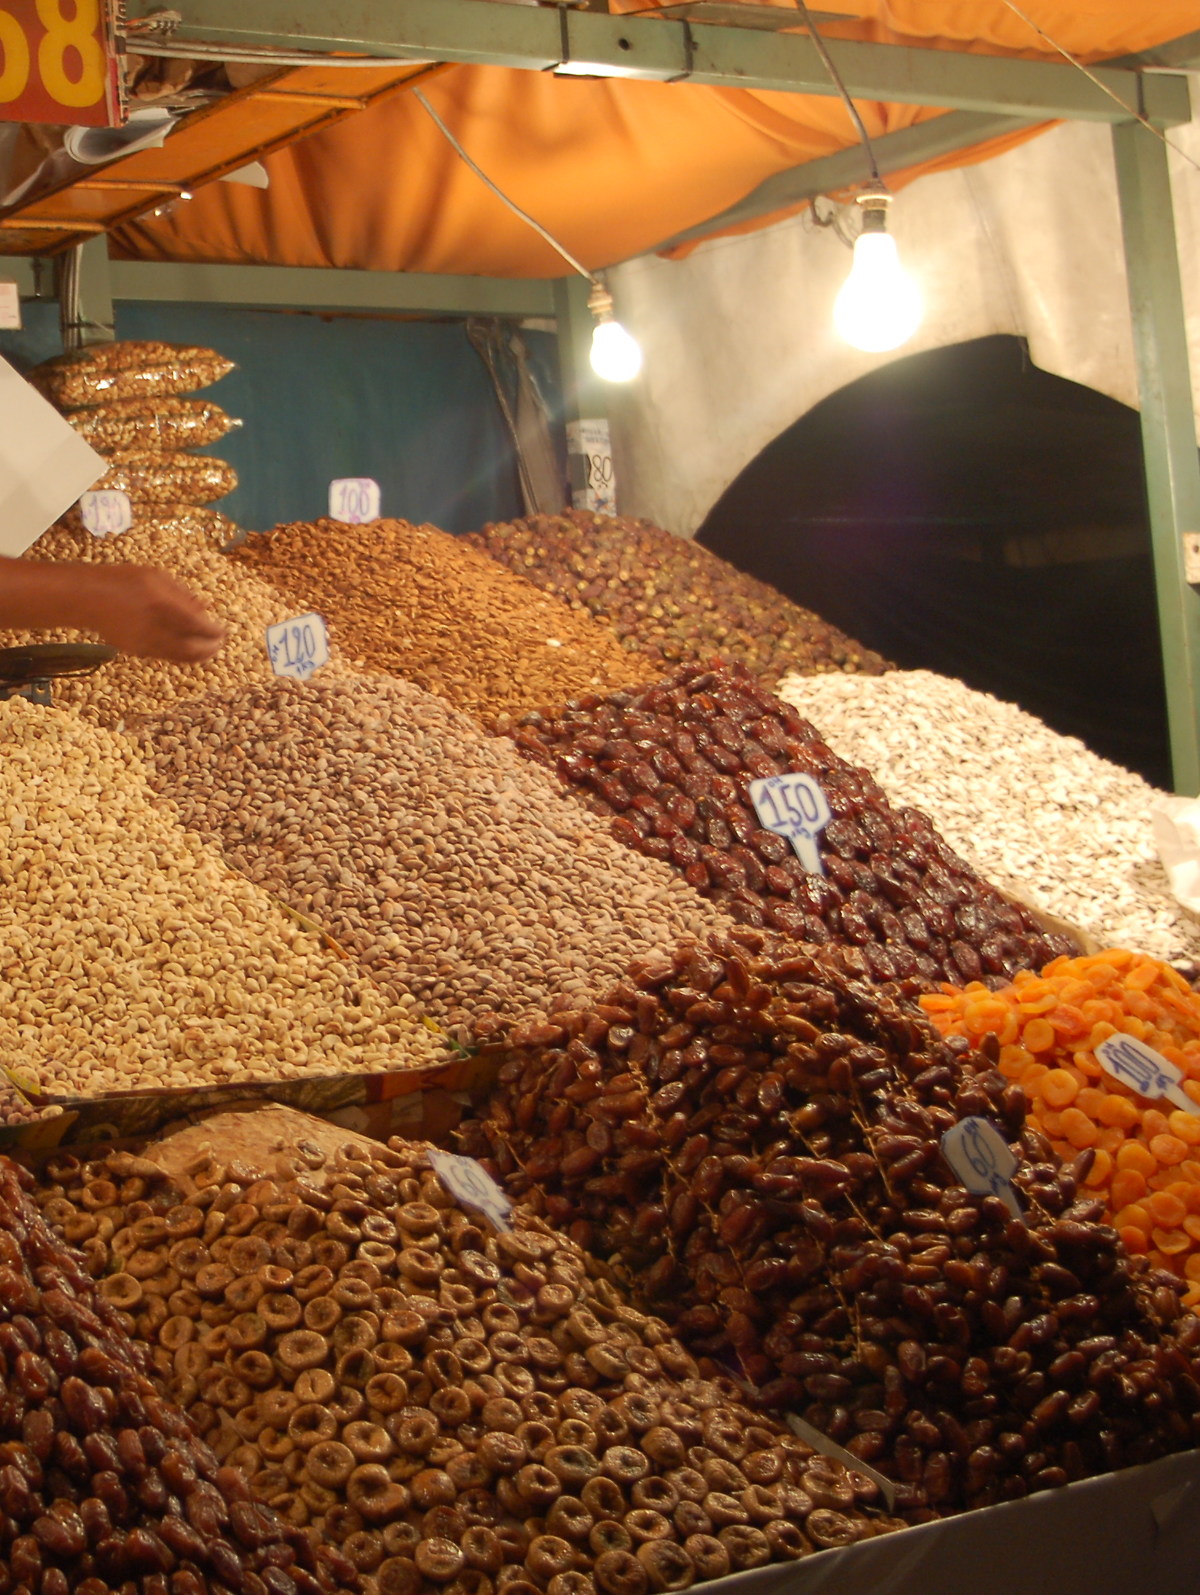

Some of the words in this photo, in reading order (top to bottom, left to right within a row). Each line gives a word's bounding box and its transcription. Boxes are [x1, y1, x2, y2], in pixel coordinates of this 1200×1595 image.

[338, 484, 370, 516] 100
[279, 624, 316, 668] 120
[758, 783, 819, 828] 150
[1106, 1041, 1160, 1093] 100
[961, 1131, 996, 1178] 60
[450, 1165, 489, 1198] 60
